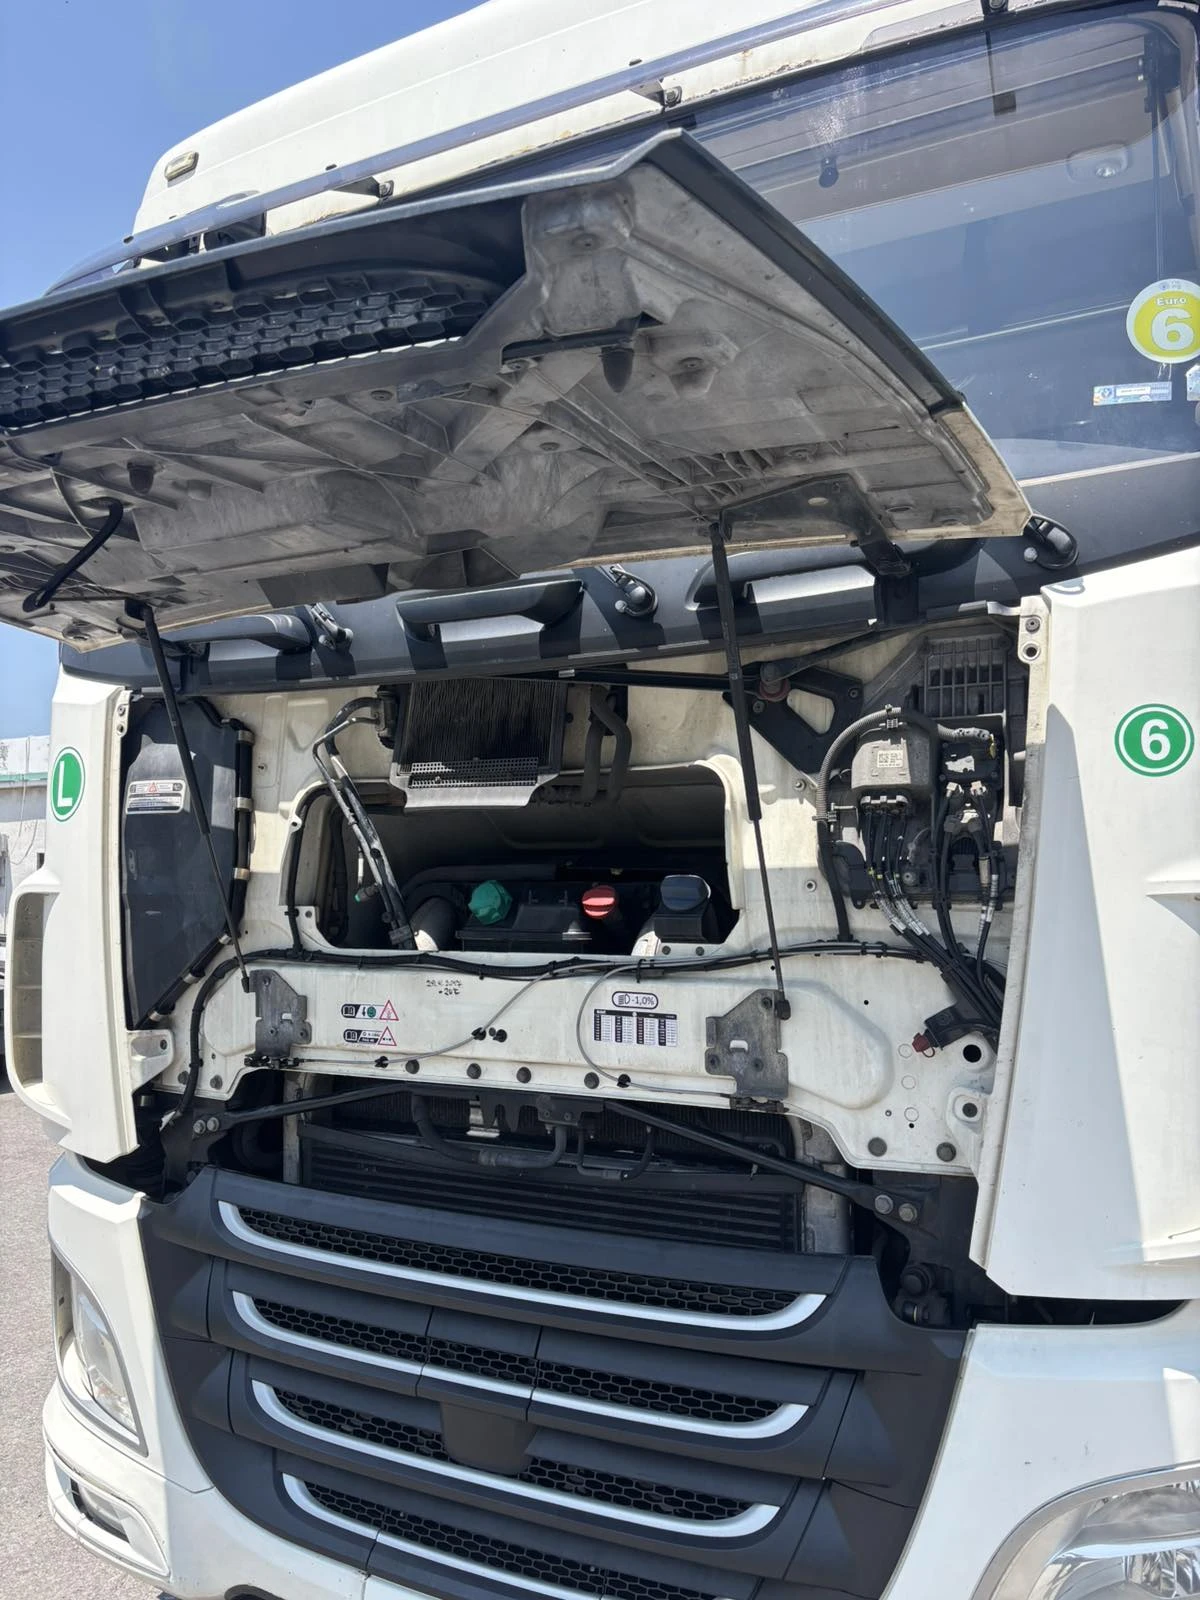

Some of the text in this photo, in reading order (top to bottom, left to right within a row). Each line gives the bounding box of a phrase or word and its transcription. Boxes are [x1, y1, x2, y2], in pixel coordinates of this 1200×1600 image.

[1156, 297, 1187, 306] Euro
[1151, 308, 1194, 351] 6
[1140, 718, 1171, 761] 6
[57, 760, 73, 808] L
